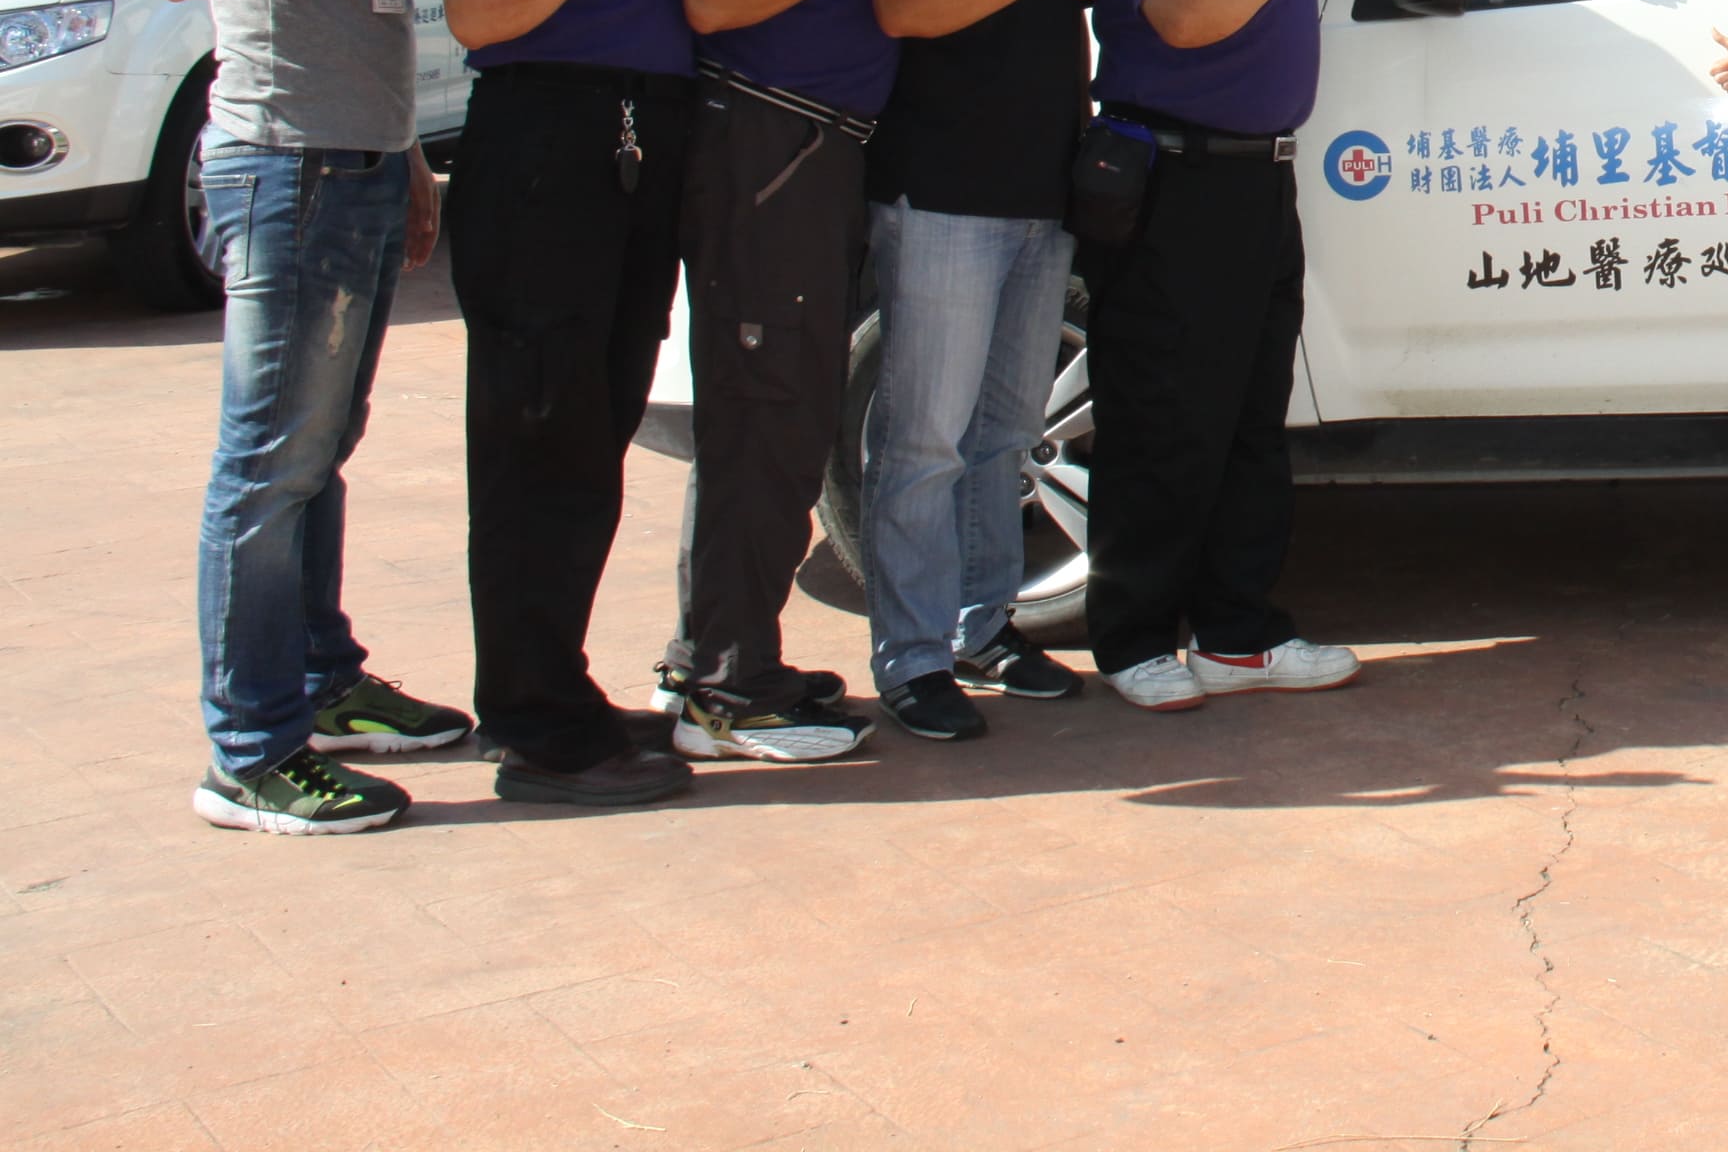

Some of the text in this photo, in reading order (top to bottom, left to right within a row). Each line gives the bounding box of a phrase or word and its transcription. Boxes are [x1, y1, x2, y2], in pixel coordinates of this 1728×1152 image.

[1406, 125, 1524, 161] 埔基醫療
[1344, 161, 1374, 171] PULI
[1410, 163, 1527, 195] 財團法人
[1472, 201, 1544, 226] Puli
[1553, 196, 1717, 223] Christian
